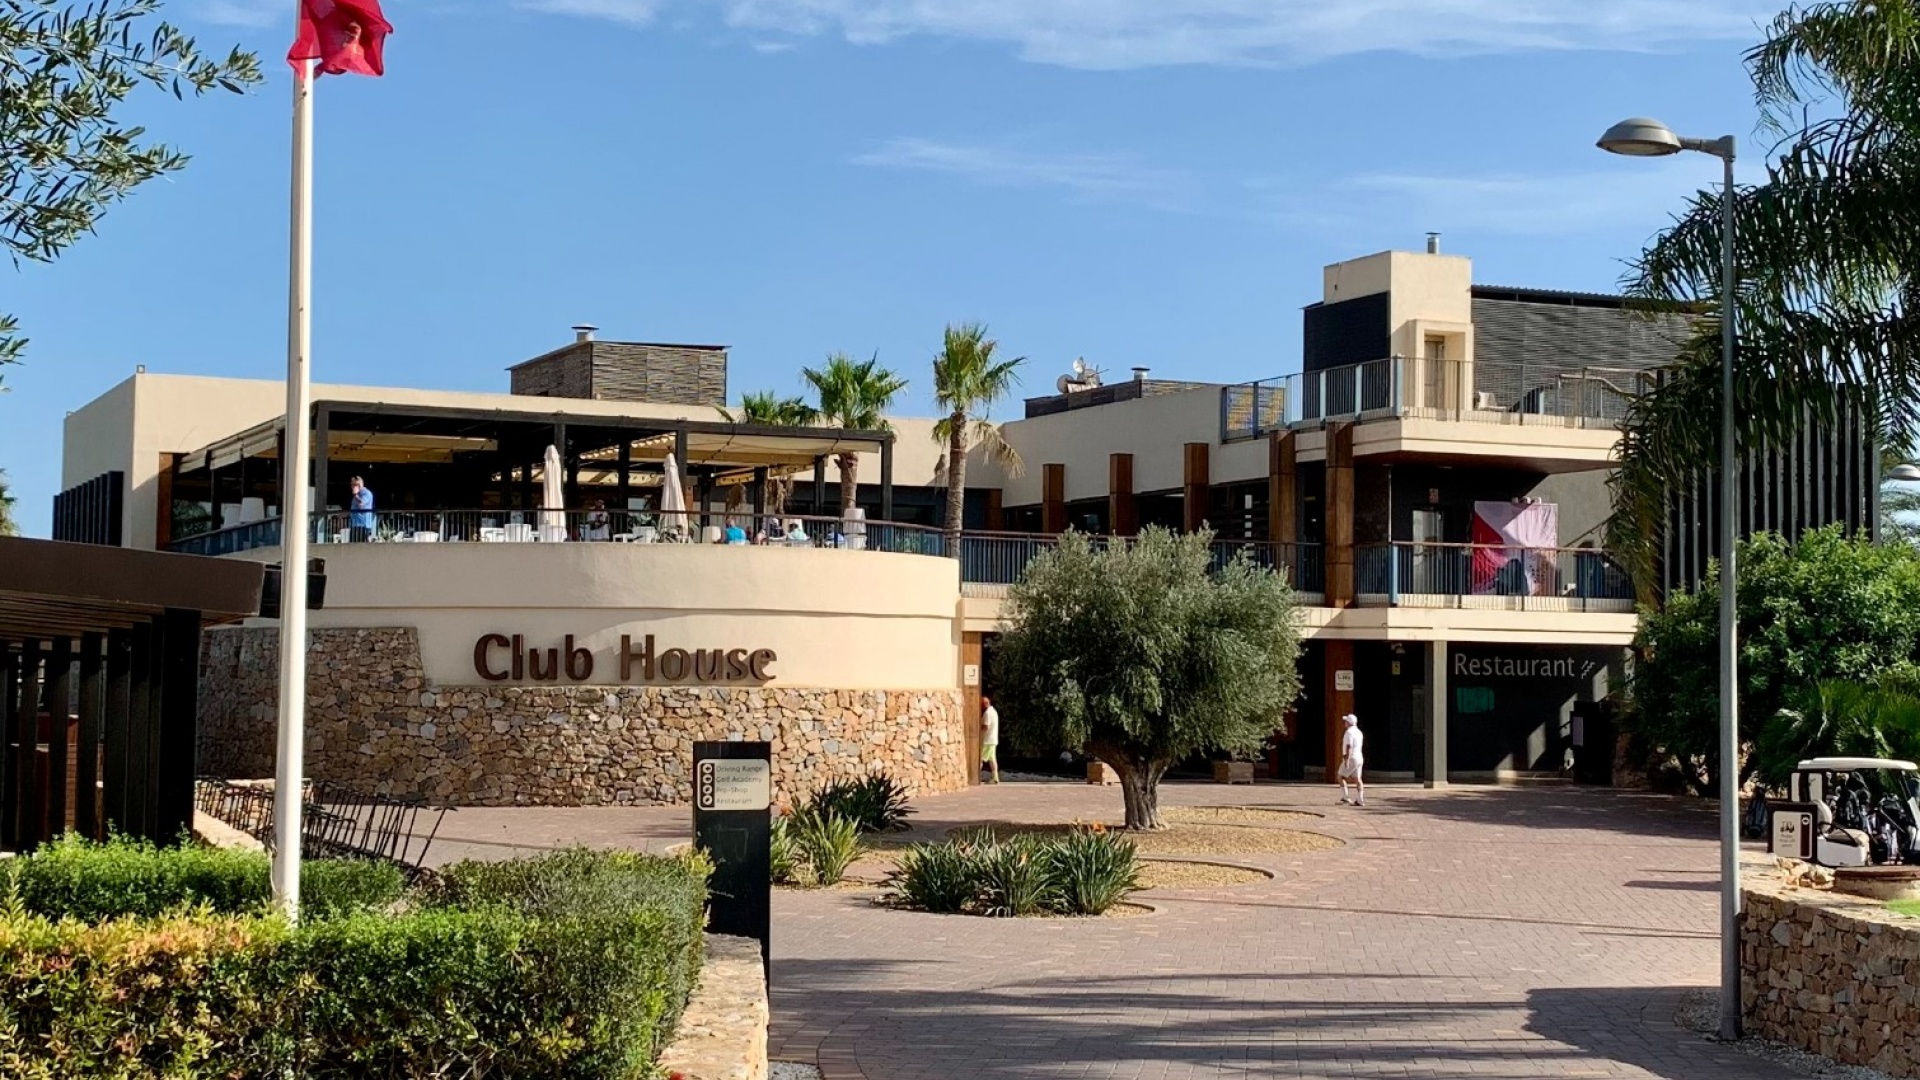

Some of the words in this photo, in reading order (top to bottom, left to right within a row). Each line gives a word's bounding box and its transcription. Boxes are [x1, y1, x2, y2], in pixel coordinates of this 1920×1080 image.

[473, 634, 594, 681] Club
[619, 634, 778, 681] House
[1454, 653, 1575, 677] Restaurant
[742, 765, 763, 773] Range
[716, 775, 731, 783] Golf
[731, 776, 763, 784] Academy
